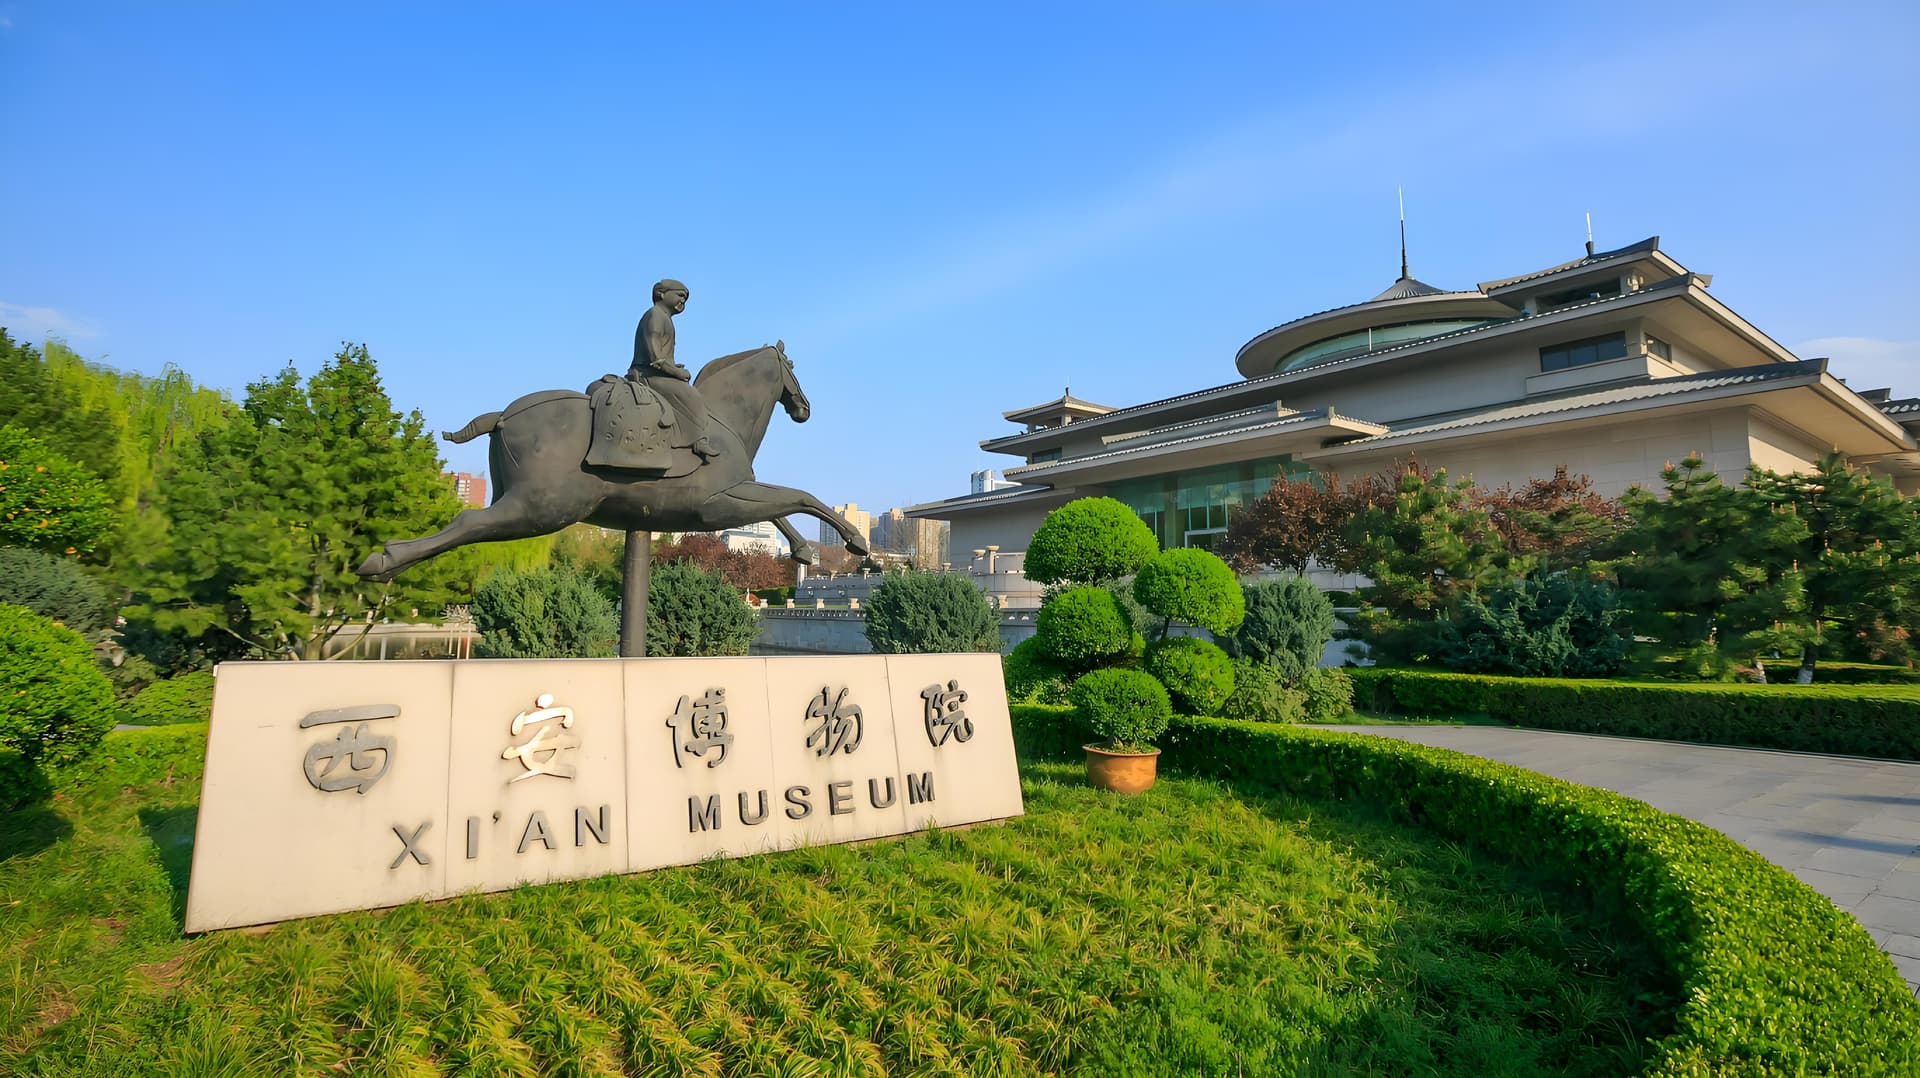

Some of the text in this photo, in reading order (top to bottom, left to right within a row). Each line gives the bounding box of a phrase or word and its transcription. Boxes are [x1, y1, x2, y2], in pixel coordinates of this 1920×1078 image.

[300, 680, 974, 794] 西安博物院
[390, 771, 936, 869] XI'AN MUSEUM
